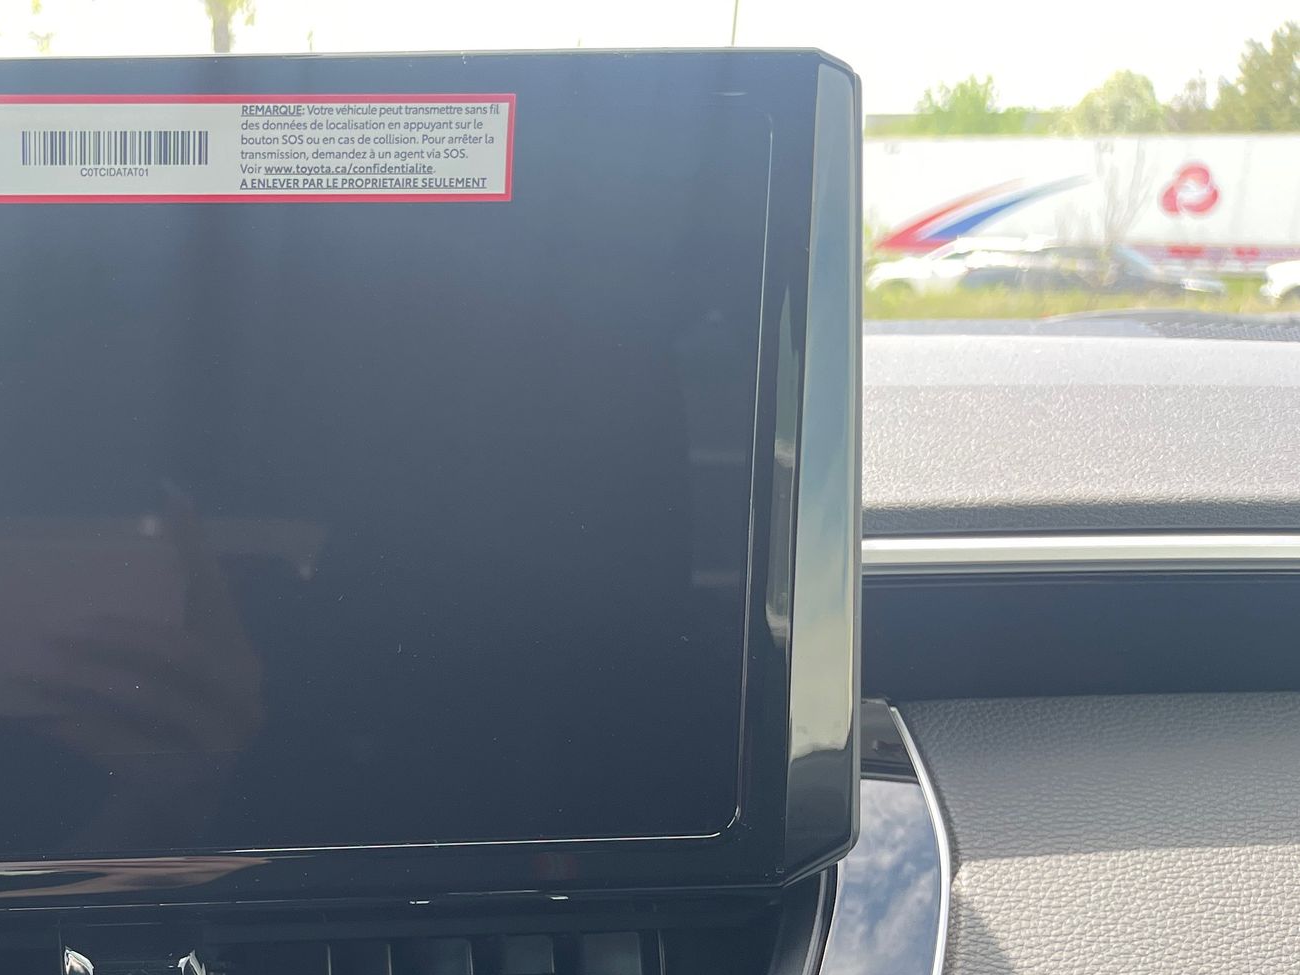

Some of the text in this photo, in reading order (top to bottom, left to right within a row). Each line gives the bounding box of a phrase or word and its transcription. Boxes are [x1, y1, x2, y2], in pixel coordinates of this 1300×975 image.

[241, 104, 500, 117] REMARQUE: Votre véhicule peut transmettre sans fil
[241, 119, 483, 132] des données de localisation en appuyant sur le
[241, 133, 495, 145] bouton SOS ou en cas de collision. Pour arrêter la
[240, 148, 469, 162] transmission, demandez à un agent via SOS.
[240, 163, 263, 174] Voir
[250, 178, 300, 190] ENLEVER
[302, 178, 324, 190] PAR
[325, 178, 339, 190] LE
[340, 178, 419, 190] PROPRIETAIRE
[420, 178, 488, 190] SEULEMENT
